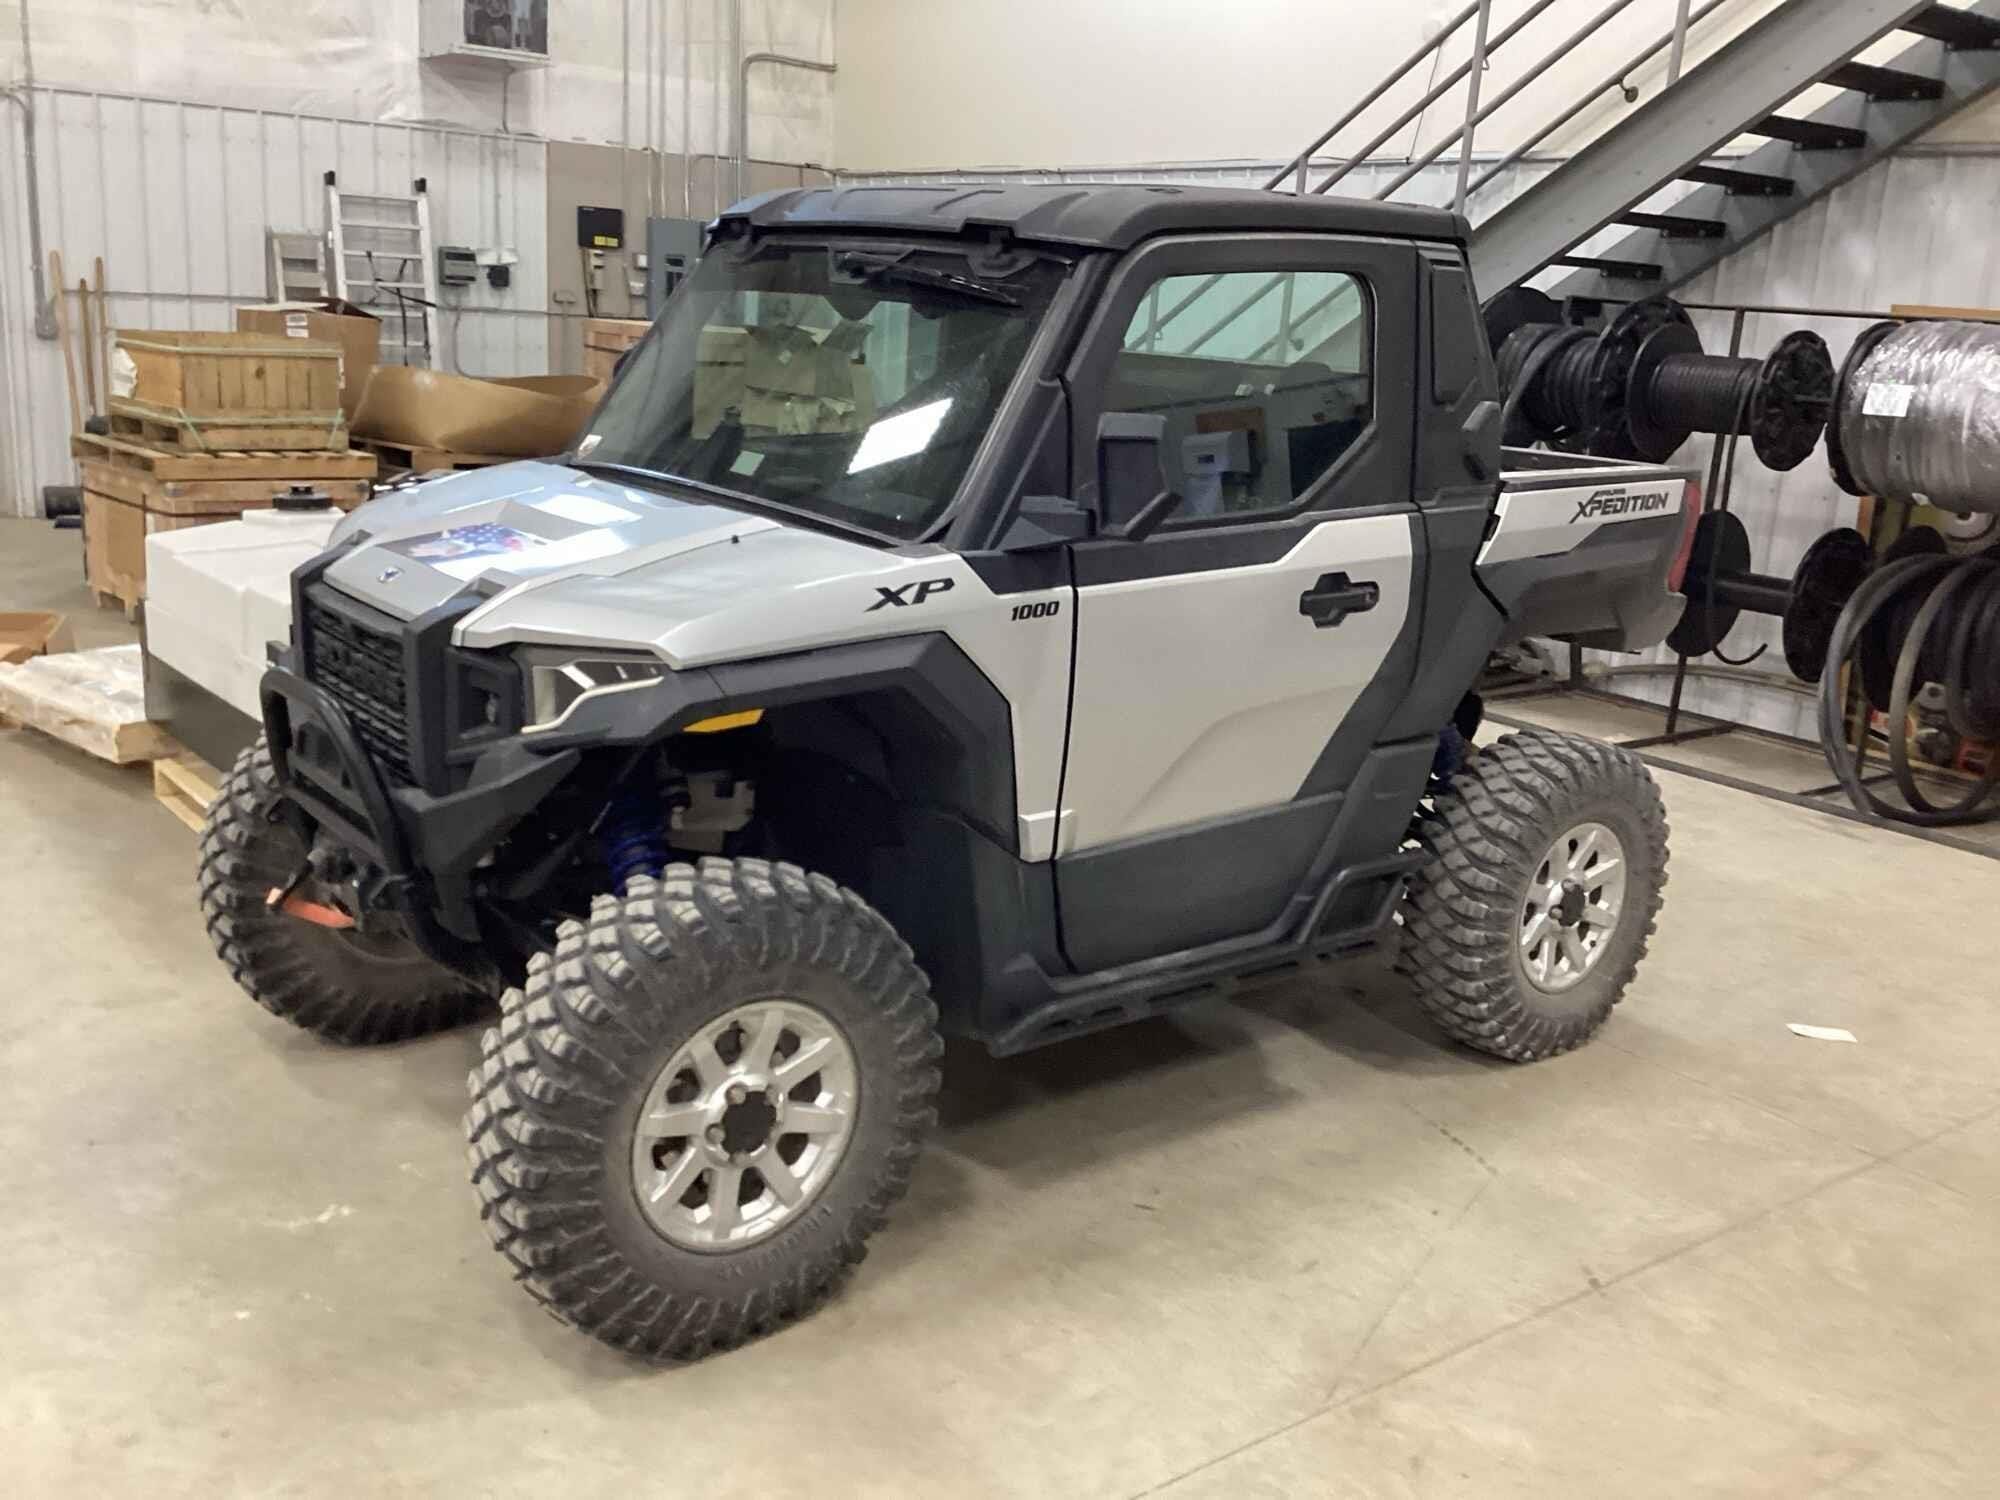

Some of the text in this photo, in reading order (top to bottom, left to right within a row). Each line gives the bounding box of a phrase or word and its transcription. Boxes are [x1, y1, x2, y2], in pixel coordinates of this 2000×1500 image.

[1569, 492, 1669, 524] XPEDITION
[864, 578, 955, 612] XP
[1011, 601, 1060, 621] 1000
